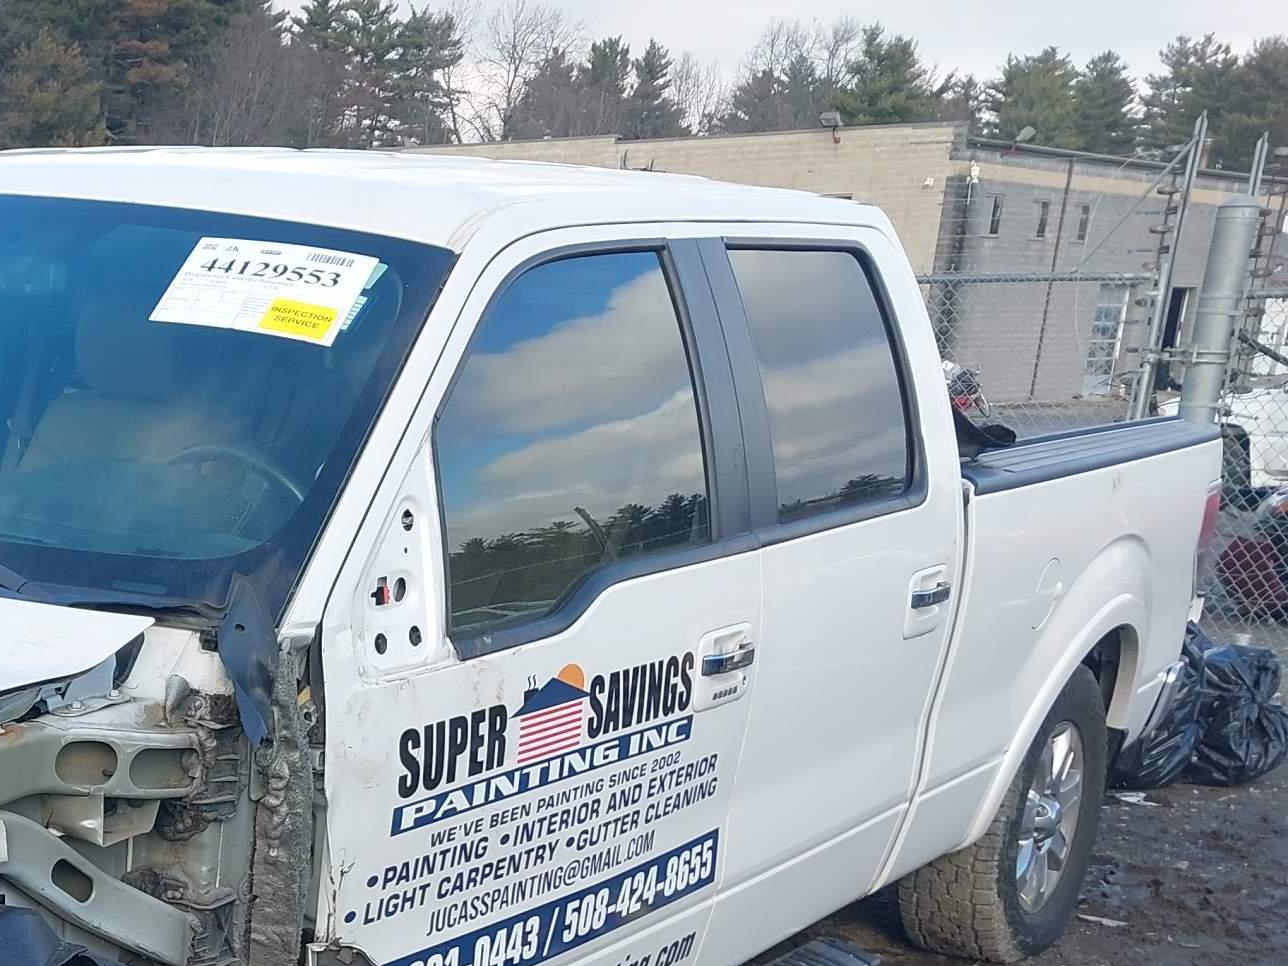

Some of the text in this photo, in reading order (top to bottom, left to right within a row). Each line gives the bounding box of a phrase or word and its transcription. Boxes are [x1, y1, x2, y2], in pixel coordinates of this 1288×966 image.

[200, 257, 341, 287] 44129553
[271, 306, 332, 322] INSPECTION
[274, 315, 320, 329] SERVICE
[398, 651, 694, 798] SUPER SAVINGS
[399, 719, 689, 831] PAINTING INC
[363, 776, 718, 926] LIGHT CARPENTRY GUTTER CLEANING
[381, 753, 718, 890] PAINTING INTERIOR AND EXTERIOR
[430, 750, 682, 847] WE'VE BEEN PAINTING SINCE 2002
[426, 829, 656, 936] JUCASSPAINTING@GMAIL.COM
[562, 837, 713, 943] 508-424-8655
